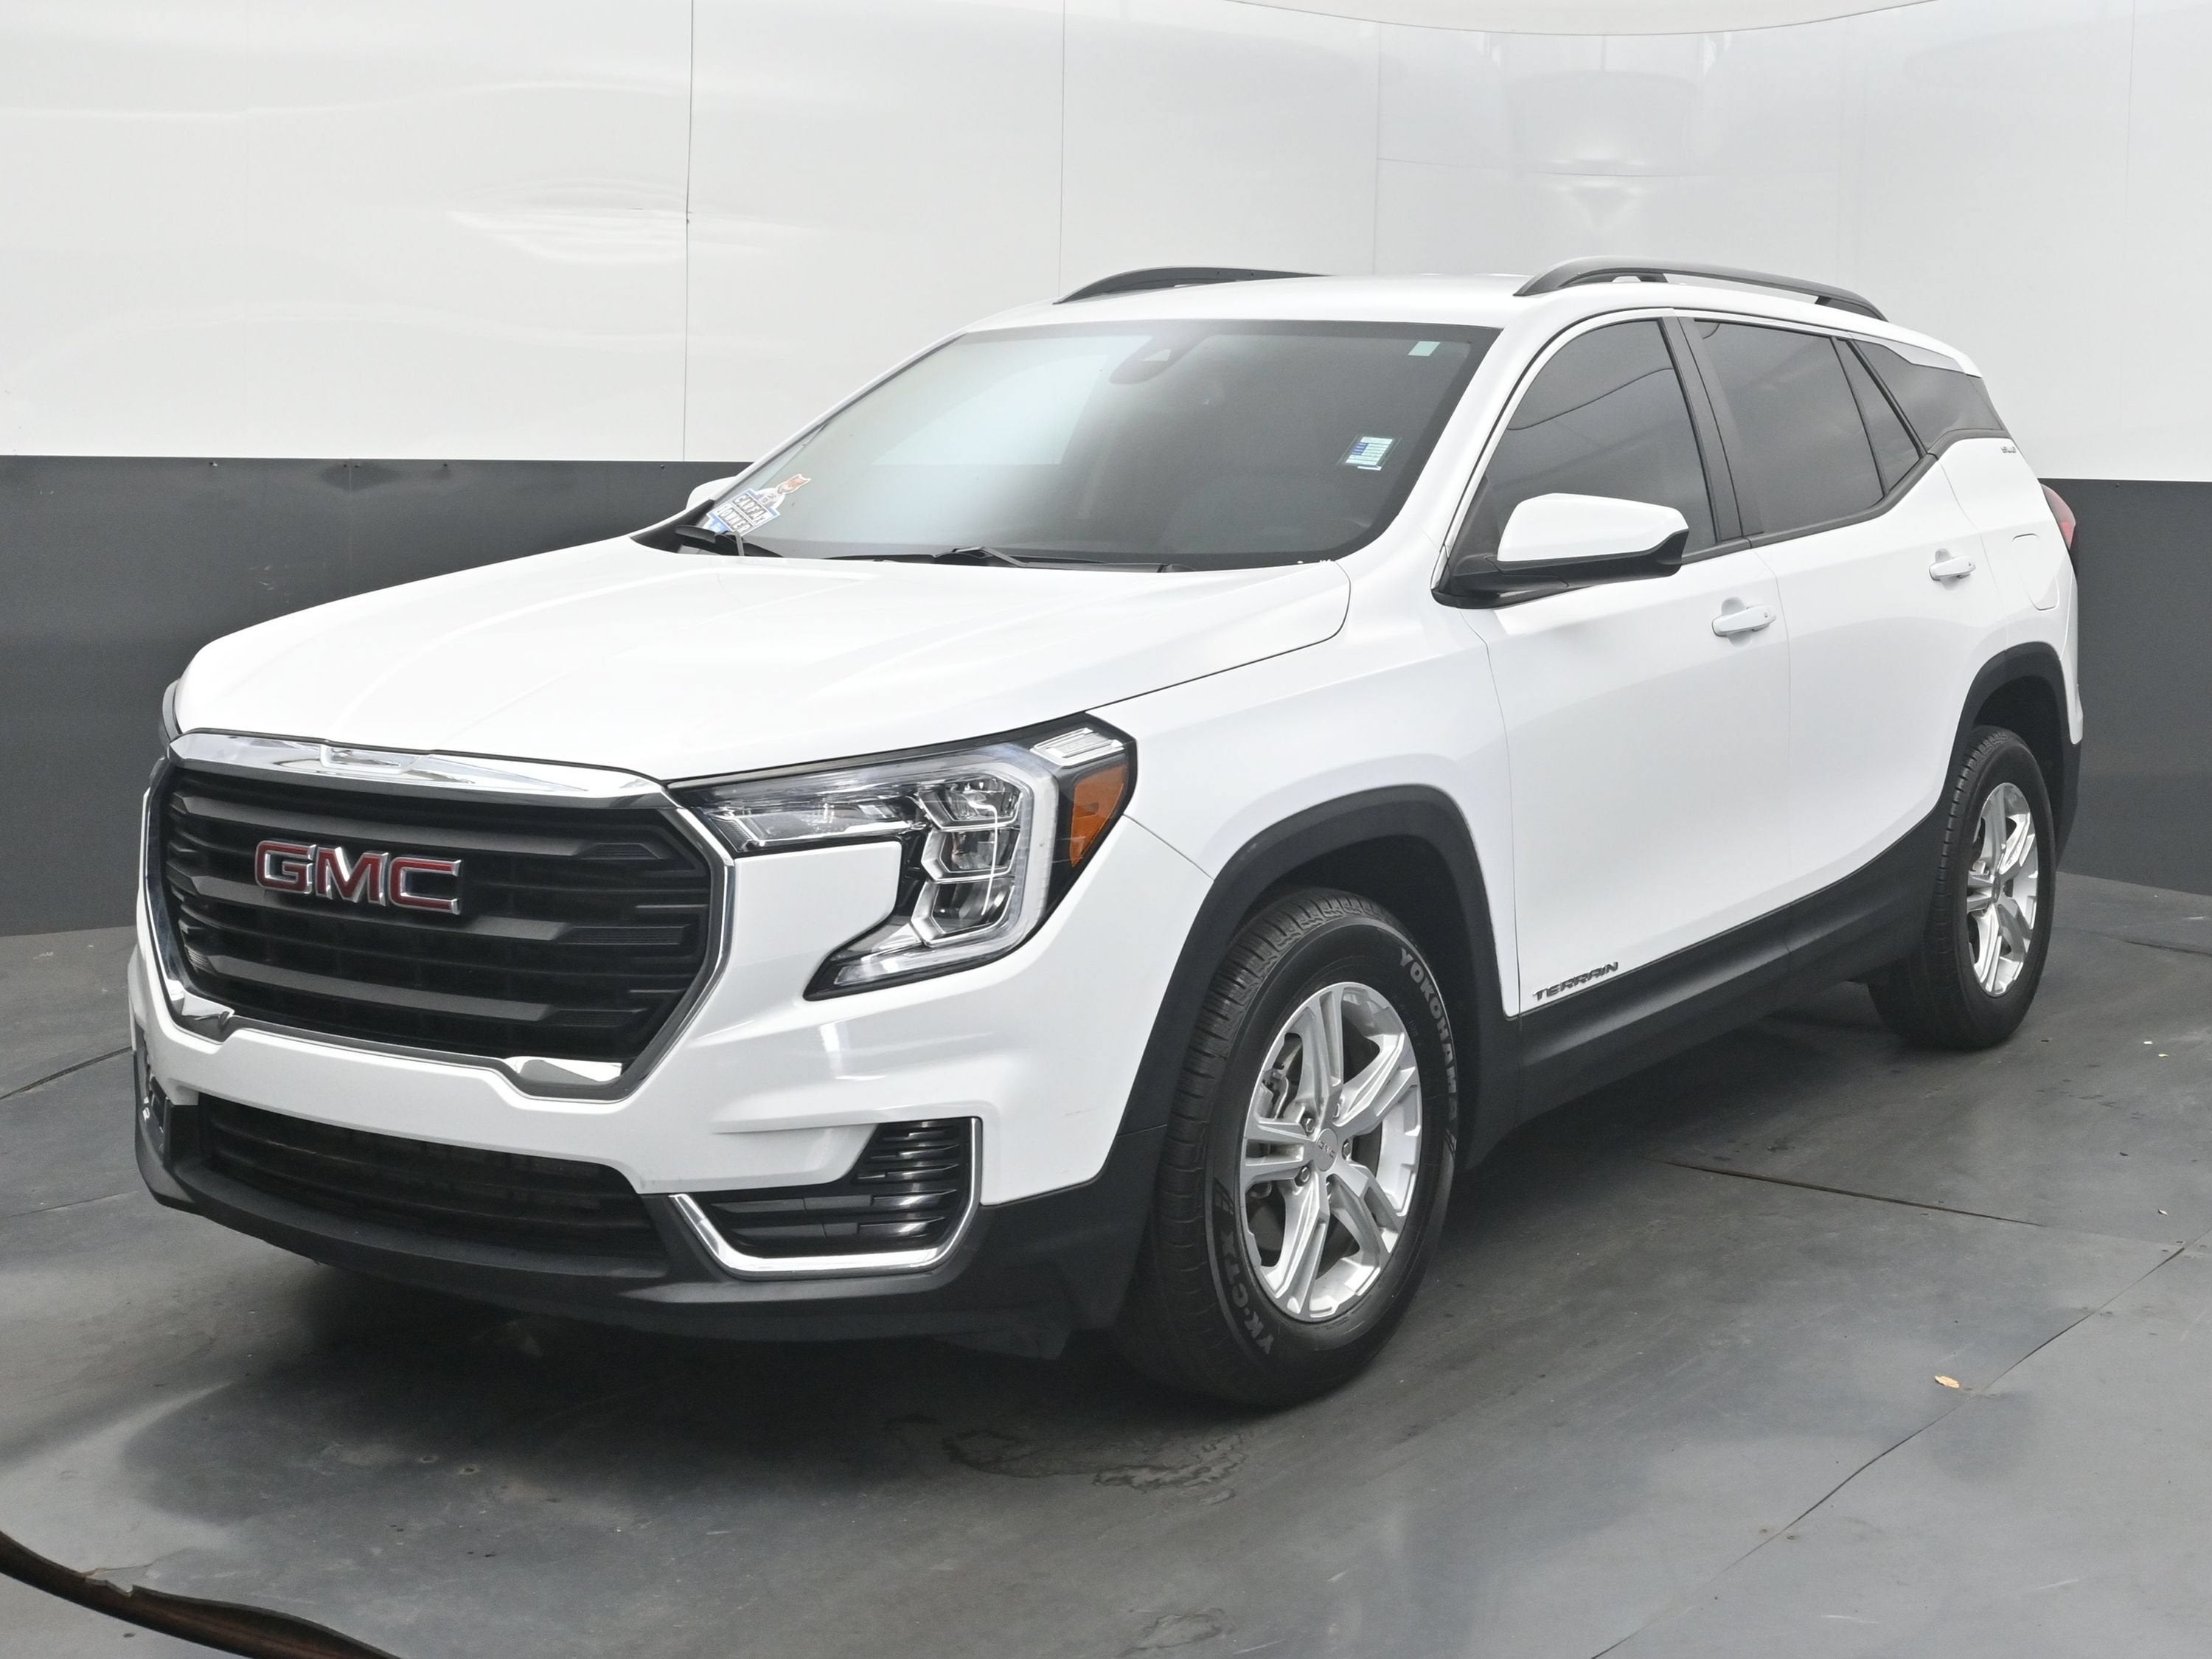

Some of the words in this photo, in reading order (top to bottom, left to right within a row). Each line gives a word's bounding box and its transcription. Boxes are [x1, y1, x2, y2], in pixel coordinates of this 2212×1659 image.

[734, 494, 769, 526] CARFAX
[254, 840, 462, 916] GMC
[1533, 961, 1618, 1001] TERRAIN
[1400, 947, 1457, 1121] YOKOHAMA
